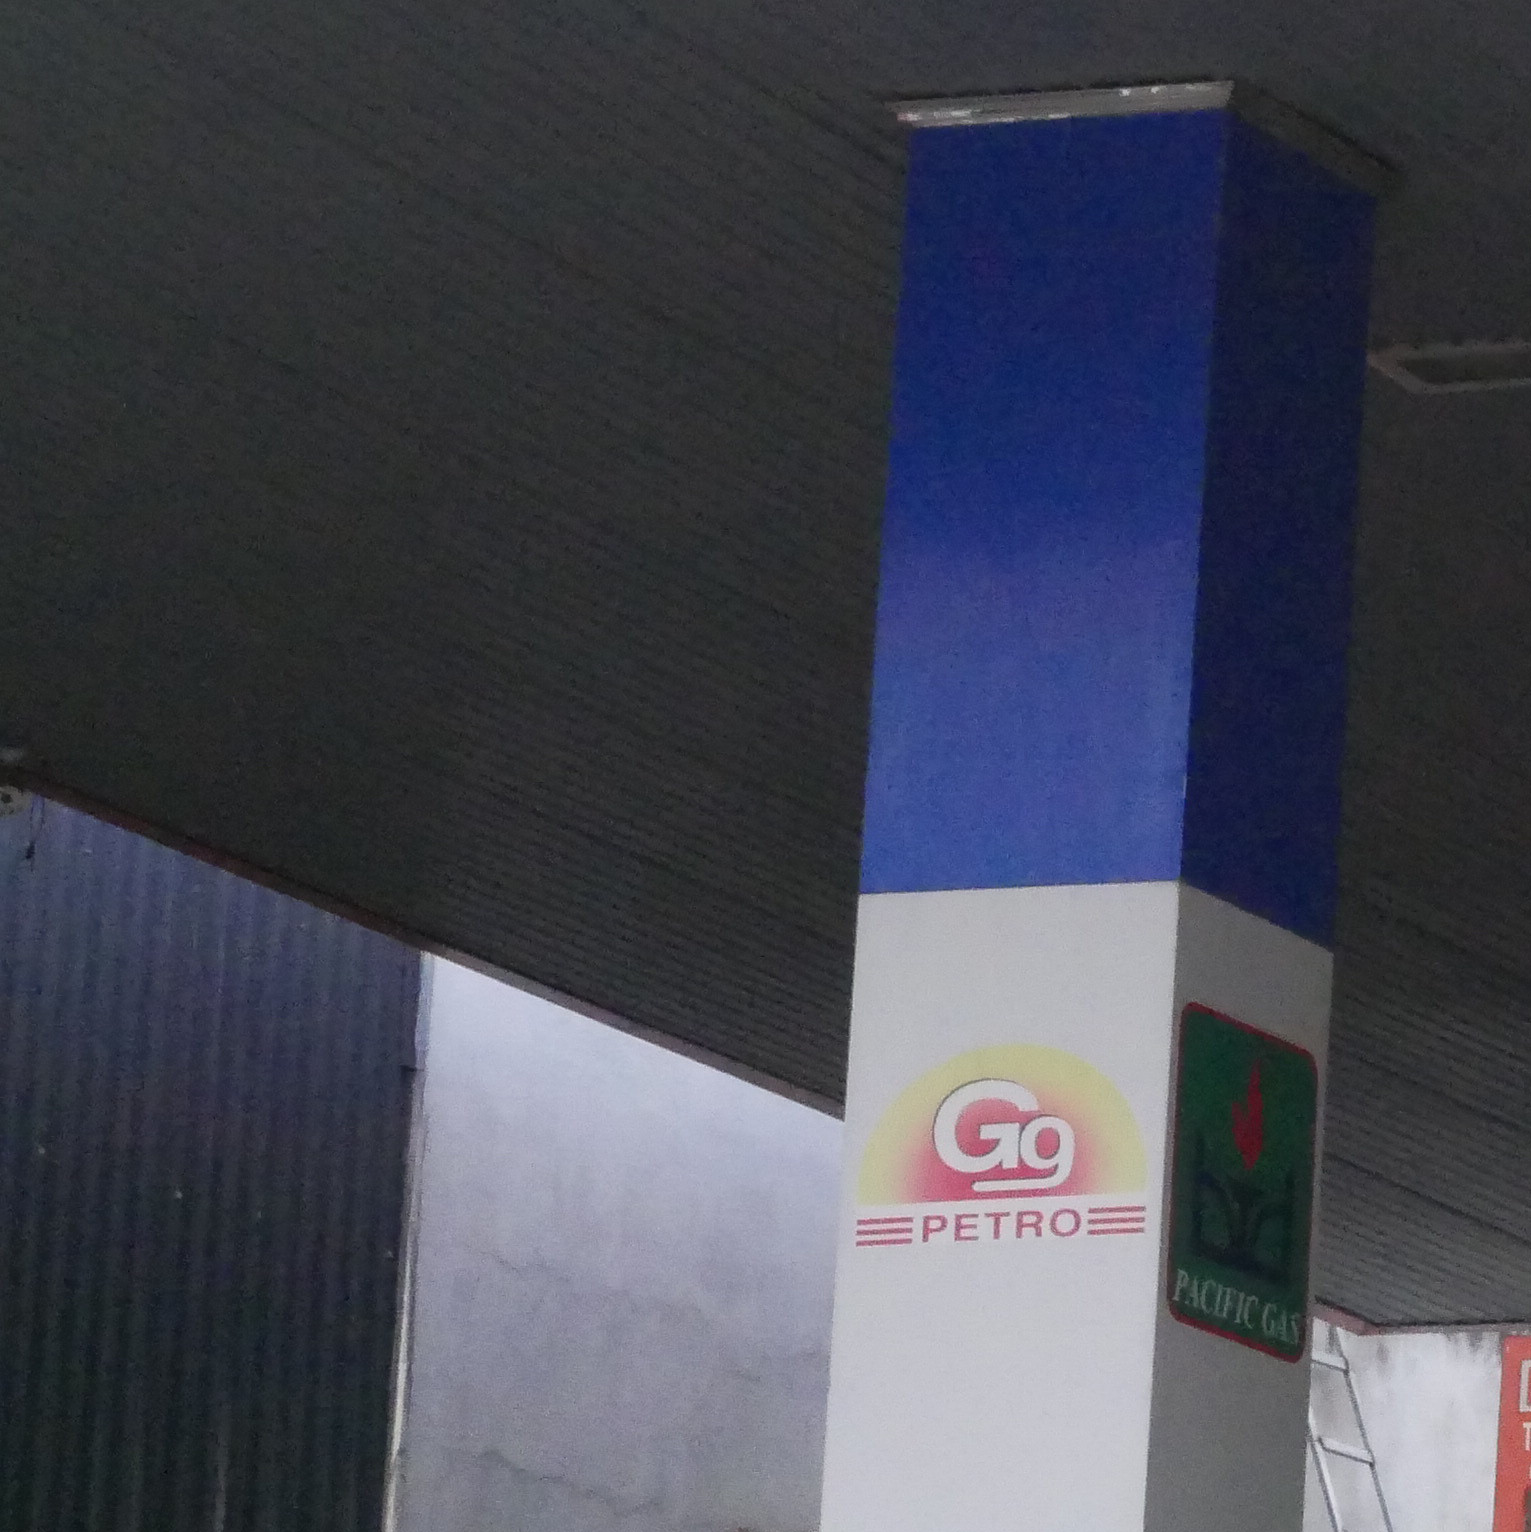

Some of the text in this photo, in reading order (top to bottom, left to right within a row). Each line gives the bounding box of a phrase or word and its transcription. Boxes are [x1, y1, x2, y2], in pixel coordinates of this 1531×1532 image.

[921, 1207, 1082, 1243] PETRO
[1172, 1268, 1301, 1347] PACIFIC GAS
